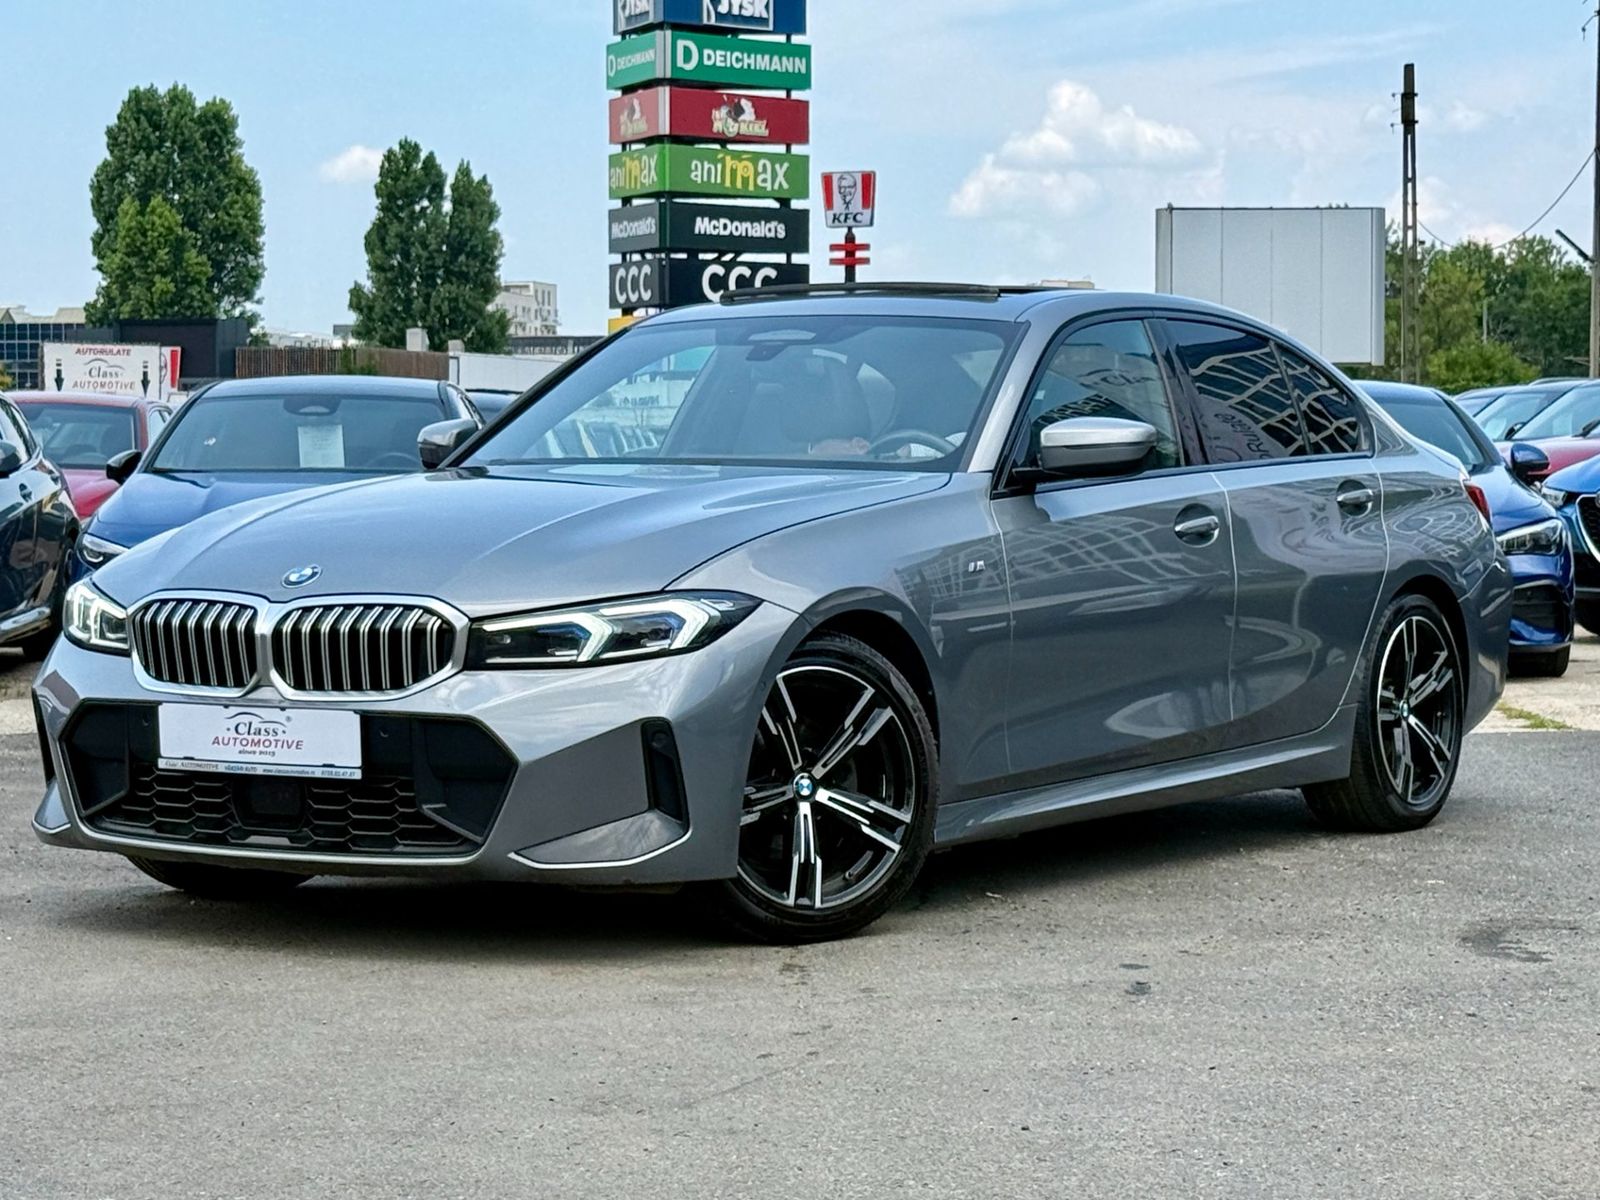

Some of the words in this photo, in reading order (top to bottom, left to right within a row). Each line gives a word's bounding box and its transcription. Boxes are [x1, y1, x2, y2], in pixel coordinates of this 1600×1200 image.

[717, 0, 769, 19] JYSK
[703, 48, 807, 74] DEICHMANN
[690, 153, 790, 192] animax
[831, 211, 864, 224] KFC
[611, 216, 656, 239] McDonald's
[694, 216, 786, 239] McDonald's
[614, 264, 652, 304] CCC
[75, 346, 132, 356] AUTORULATE
[88, 366, 120, 379] Class
[72, 380, 136, 390] AUTOMOTIVE
[234, 720, 280, 737] Class
[211, 735, 305, 750] AUTOMOTIVE
